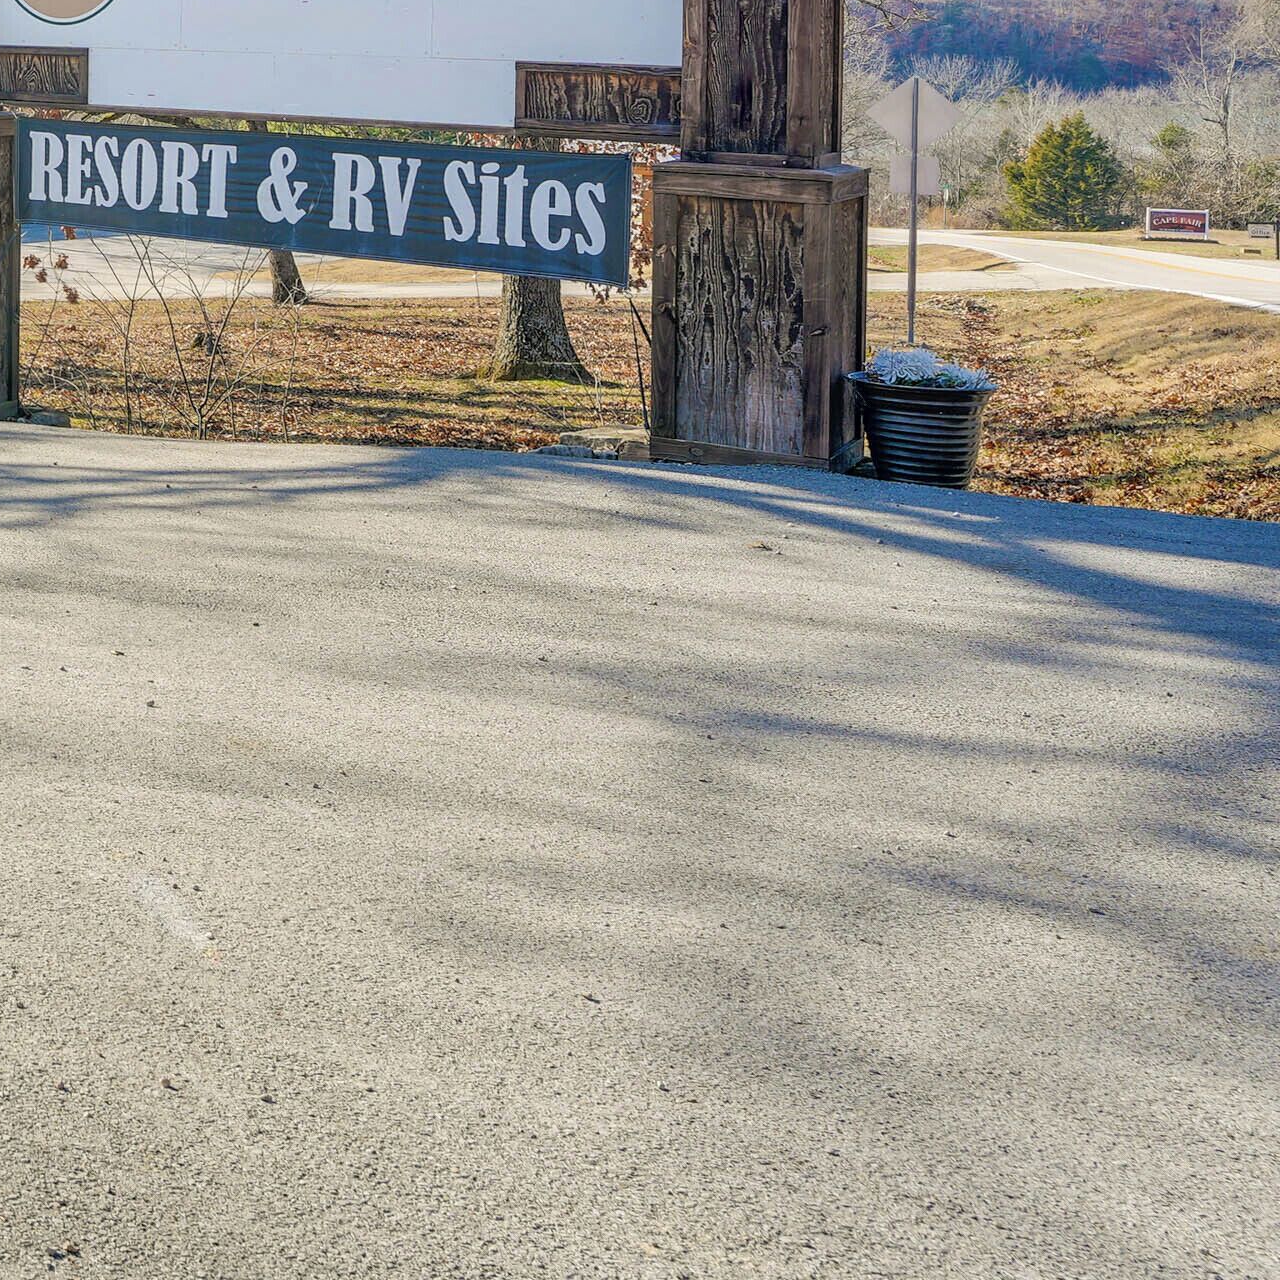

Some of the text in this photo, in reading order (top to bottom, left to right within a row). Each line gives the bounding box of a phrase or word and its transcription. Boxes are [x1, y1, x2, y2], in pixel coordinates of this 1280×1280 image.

[27, 129, 607, 257] RESORT & RV Sites
[1152, 216, 1202, 228] CAPE FAIR
